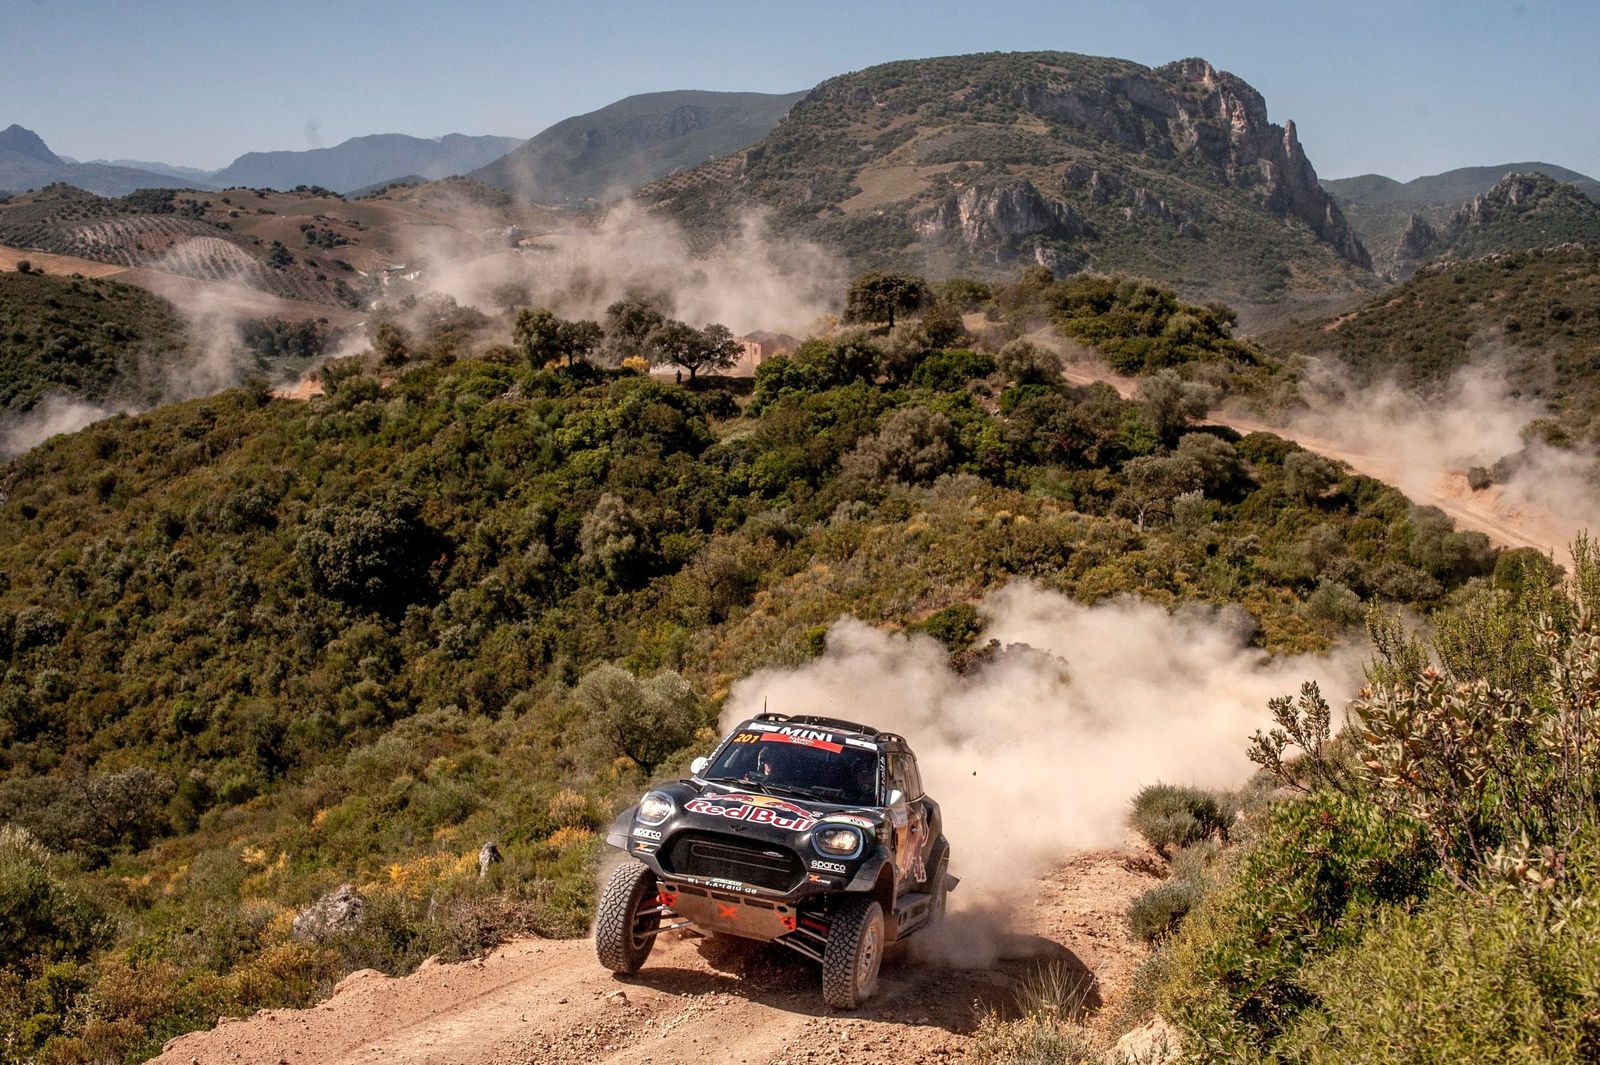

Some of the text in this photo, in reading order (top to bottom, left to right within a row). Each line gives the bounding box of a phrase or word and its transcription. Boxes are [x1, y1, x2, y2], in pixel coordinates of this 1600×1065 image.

[733, 733, 760, 744] 201
[779, 727, 833, 742] MINI
[684, 798, 817, 831] Red Bull
[811, 860, 846, 873] sparco
